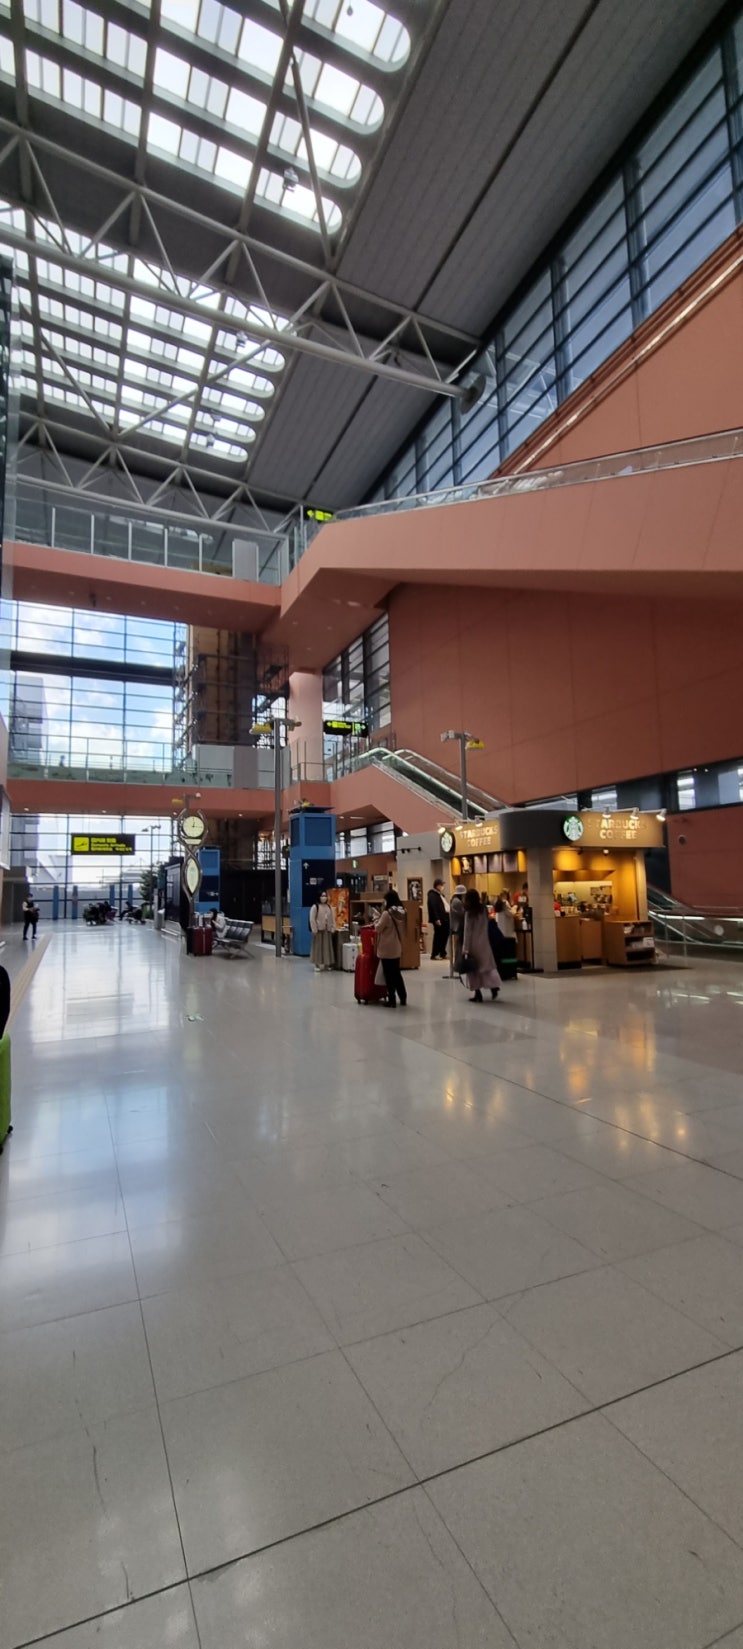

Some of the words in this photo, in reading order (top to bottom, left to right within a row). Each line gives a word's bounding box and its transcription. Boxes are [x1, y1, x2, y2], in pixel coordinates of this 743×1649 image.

[586, 819, 648, 830] STARBUCKS
[460, 825, 498, 838] STARBUCKS
[600, 829, 637, 839] COEE
[467, 836, 492, 847] COFFEE
